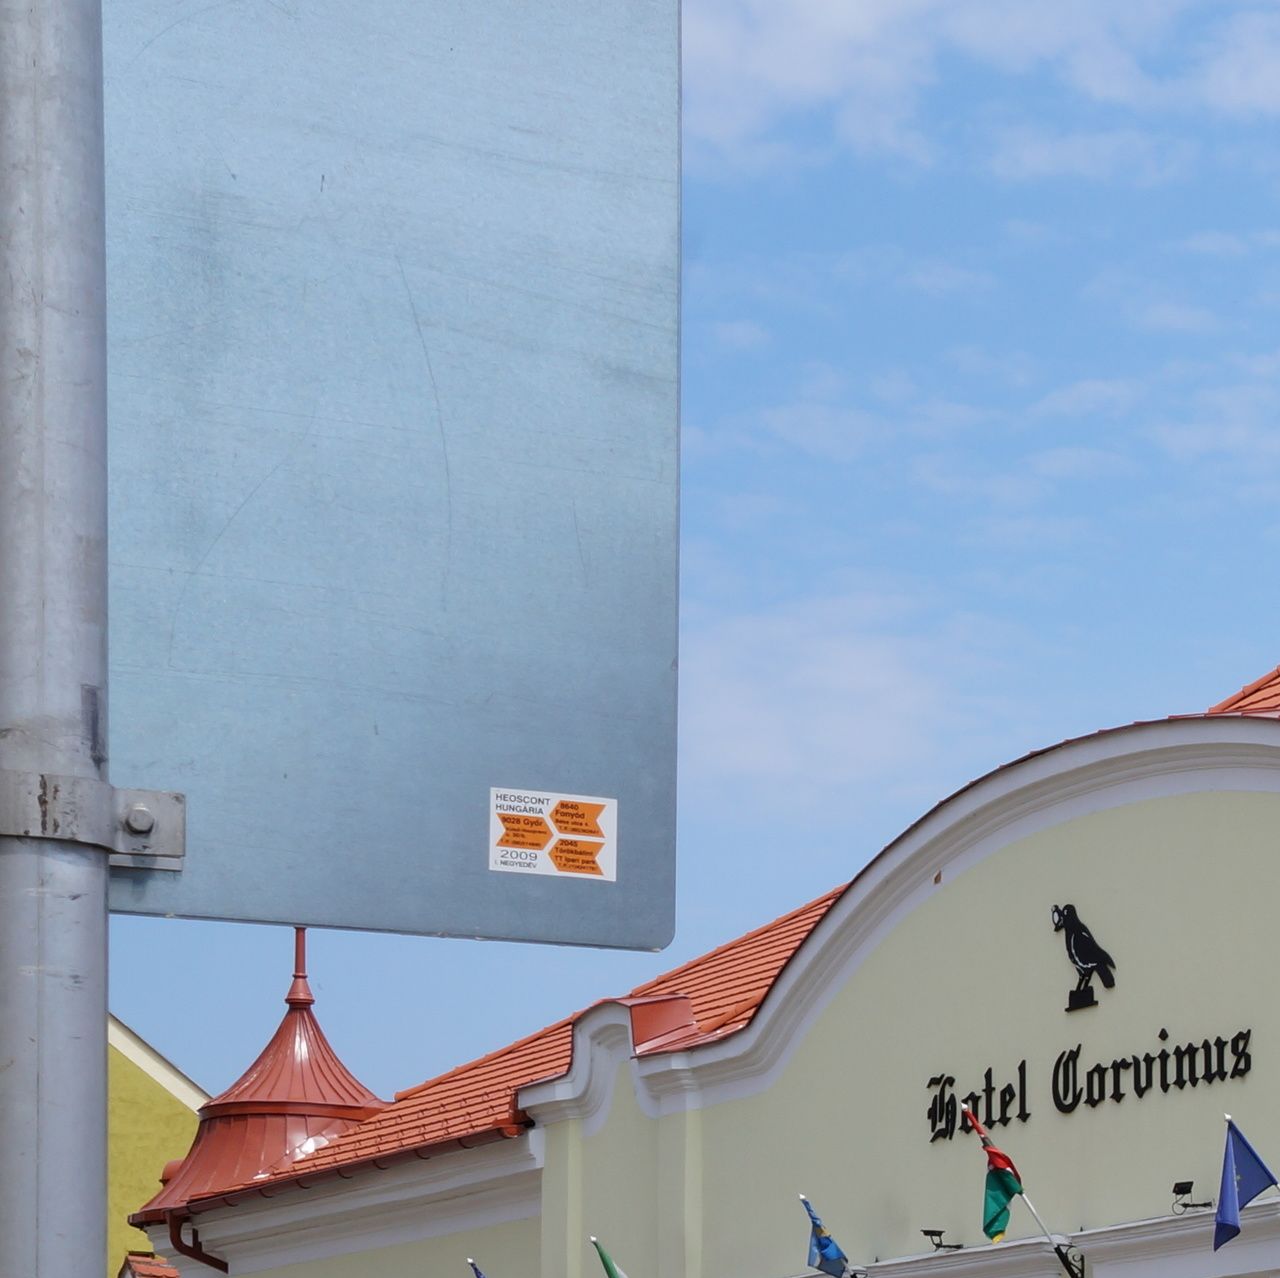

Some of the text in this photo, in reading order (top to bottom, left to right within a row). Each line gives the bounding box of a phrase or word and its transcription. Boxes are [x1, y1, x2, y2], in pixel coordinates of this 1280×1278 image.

[496, 793, 551, 806] HEOSCONT
[502, 817, 521, 825] 9028
[500, 849, 538, 862] 2009
[926, 1028, 1252, 1143] Hotel Corvinus
